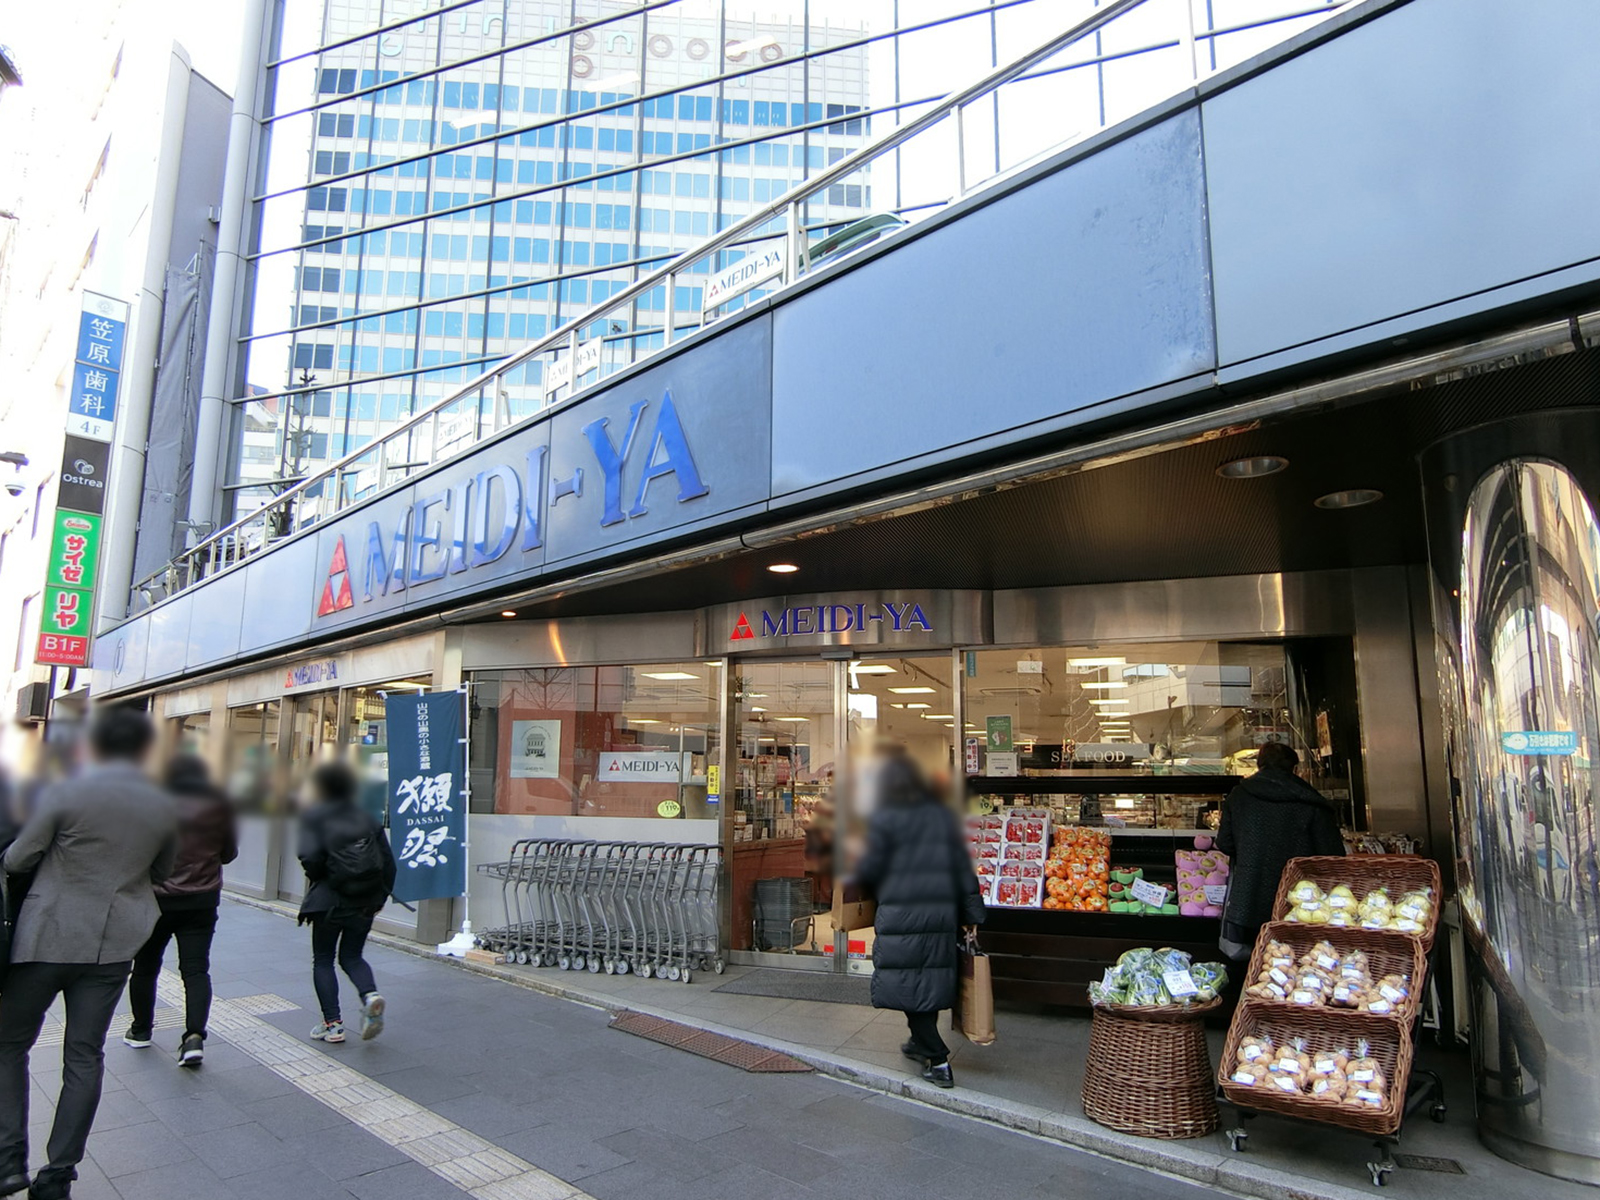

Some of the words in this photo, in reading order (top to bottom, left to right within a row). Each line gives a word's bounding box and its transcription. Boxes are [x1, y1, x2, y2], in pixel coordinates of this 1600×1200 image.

[719, 250, 781, 293] MEIDI-YA
[79, 317, 115, 416] 笠原歯科
[79, 420, 102, 436] 4F
[62, 473, 104, 489] Ostrea
[362, 387, 711, 604] MEIDI-YA
[53, 534, 86, 629] サイゼリヤ
[761, 602, 934, 638] MEIDI-YA
[44, 636, 81, 652] B1F
[621, 759, 681, 773] MEIDI-YA
[406, 814, 446, 827] DASSAI
